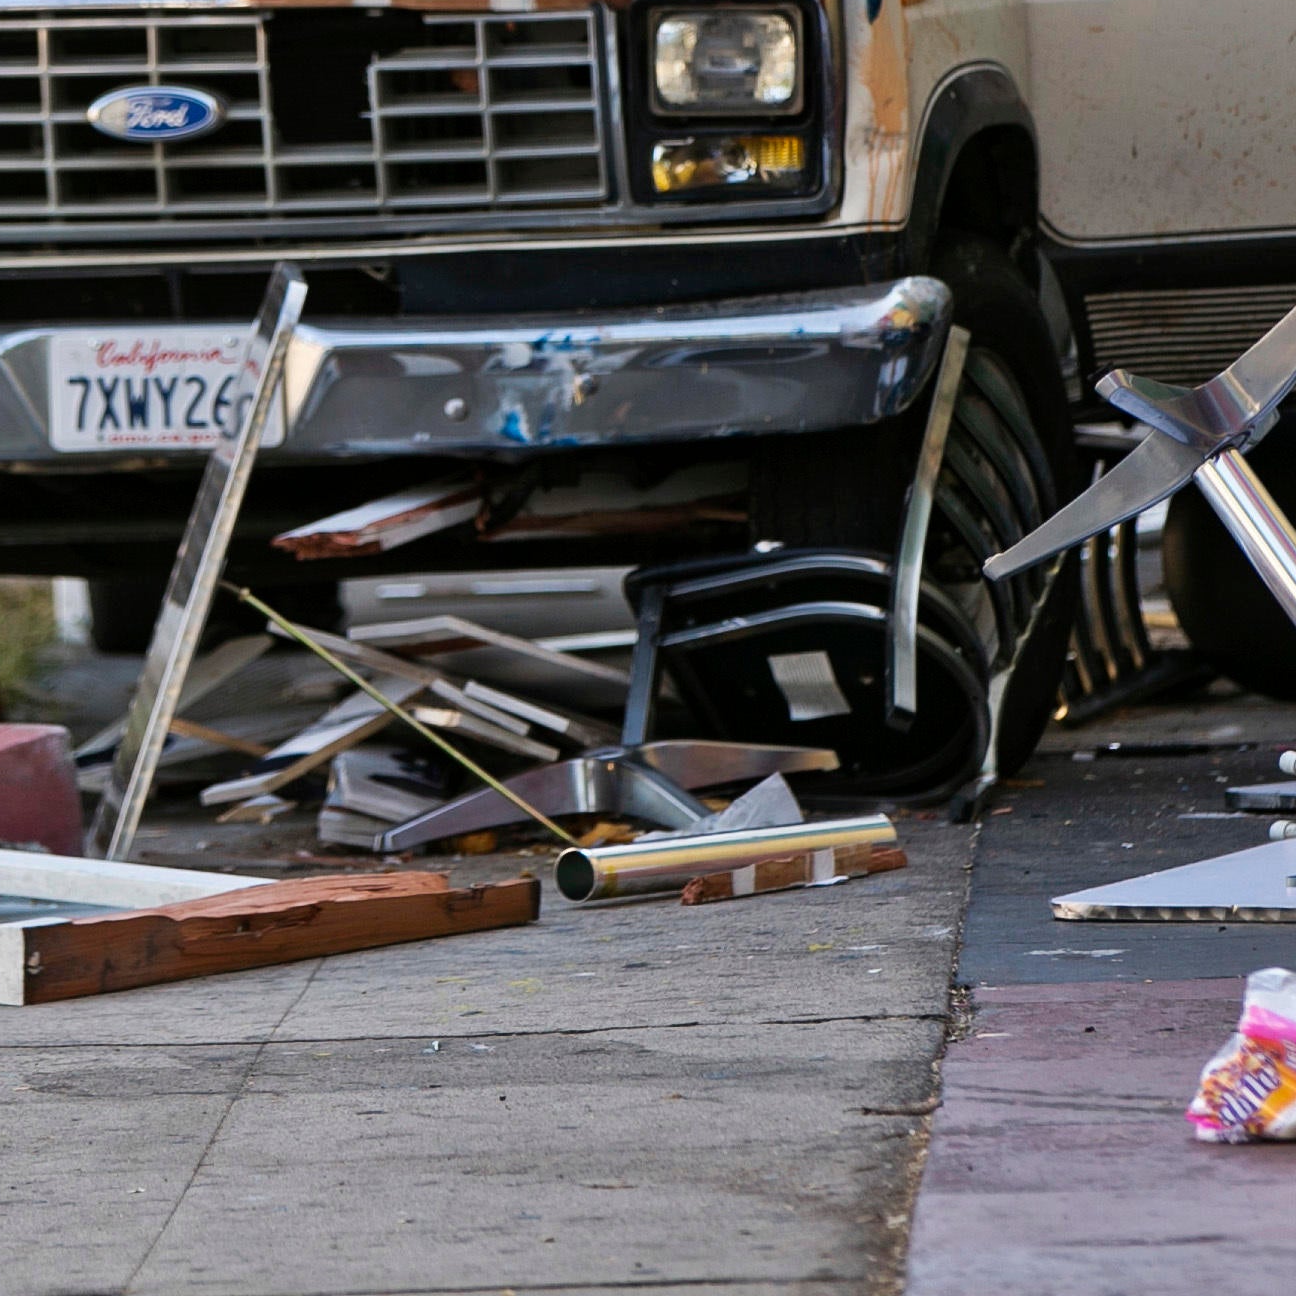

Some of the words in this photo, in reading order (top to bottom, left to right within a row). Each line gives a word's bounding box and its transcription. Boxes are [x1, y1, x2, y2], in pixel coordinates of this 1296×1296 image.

[127, 101, 189, 128] Ford
[97, 340, 237, 372] California
[67, 375, 246, 432] 7XWY26
